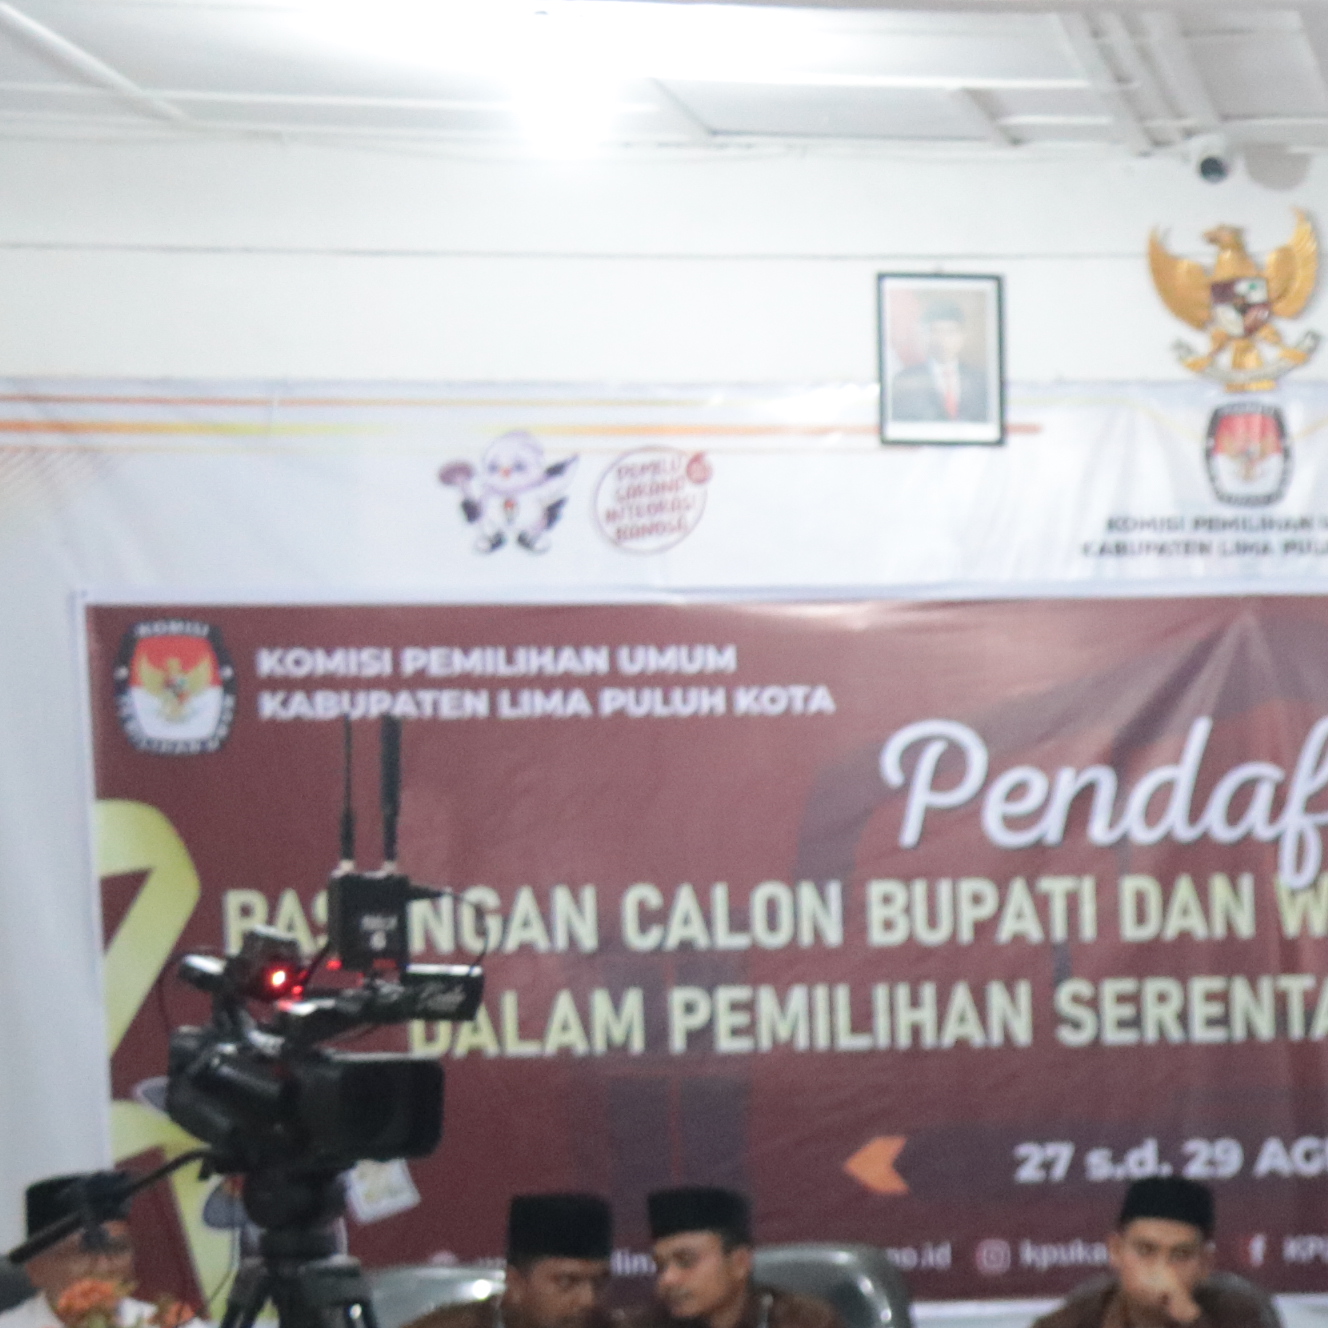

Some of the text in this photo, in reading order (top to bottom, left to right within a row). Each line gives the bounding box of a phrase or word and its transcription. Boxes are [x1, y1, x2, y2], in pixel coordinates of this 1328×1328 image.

[256, 643, 738, 678] KOMISI PEMILIHAN UMUM
[257, 684, 837, 720] KABUPATEN LIMA PULUH KOTA
[623, 881, 844, 953] CALON
[866, 874, 1097, 948] BUPATI
[1119, 873, 1256, 943] DAN
[667, 980, 1033, 1055] PEMILIHAN
[1014, 1141, 1072, 1183] 27
[1086, 1138, 1170, 1181] s.d.
[1182, 1139, 1244, 1180] 29
